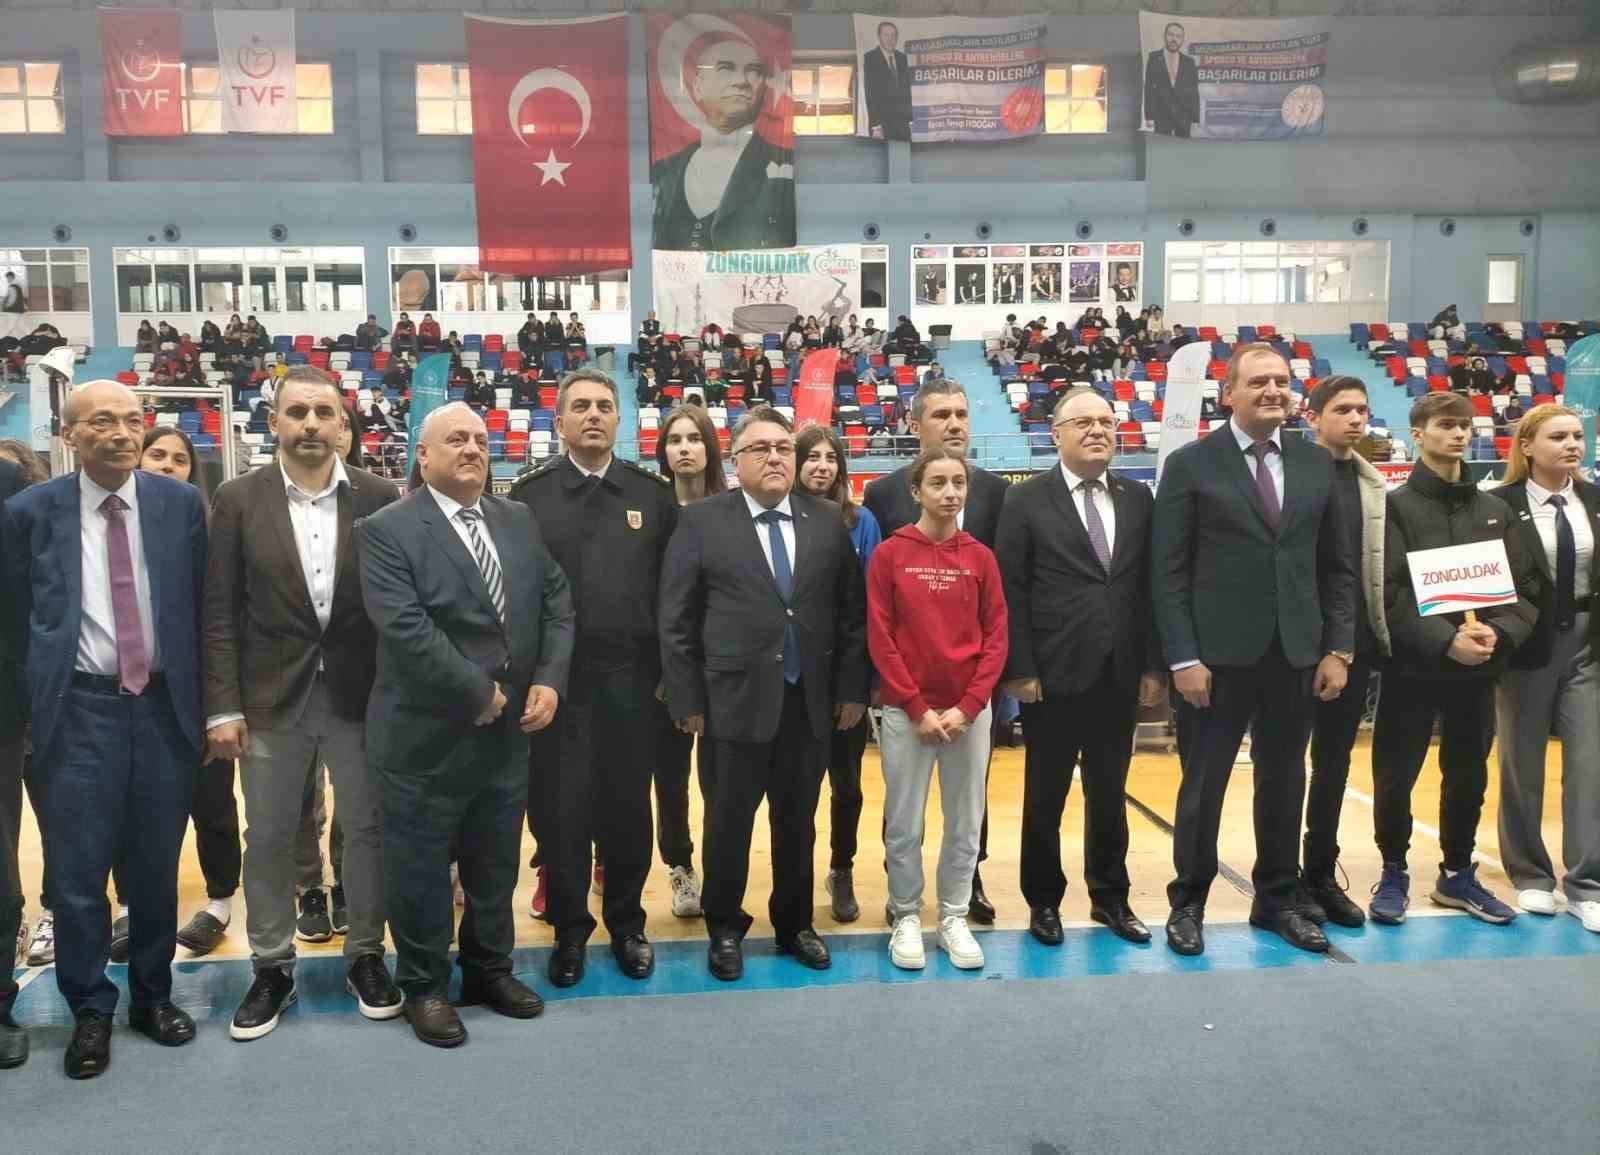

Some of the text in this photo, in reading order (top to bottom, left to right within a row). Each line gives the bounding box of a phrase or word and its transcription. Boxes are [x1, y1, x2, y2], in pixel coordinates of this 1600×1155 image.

[915, 67, 984, 84] BAŞARILAR
[1198, 69, 1266, 84] BAŞARILAR
[115, 88, 170, 110] TVF
[231, 85, 286, 106] TVF
[705, 251, 811, 274] ZONGULDAK
[1422, 562, 1501, 585] ZONGULDAK
